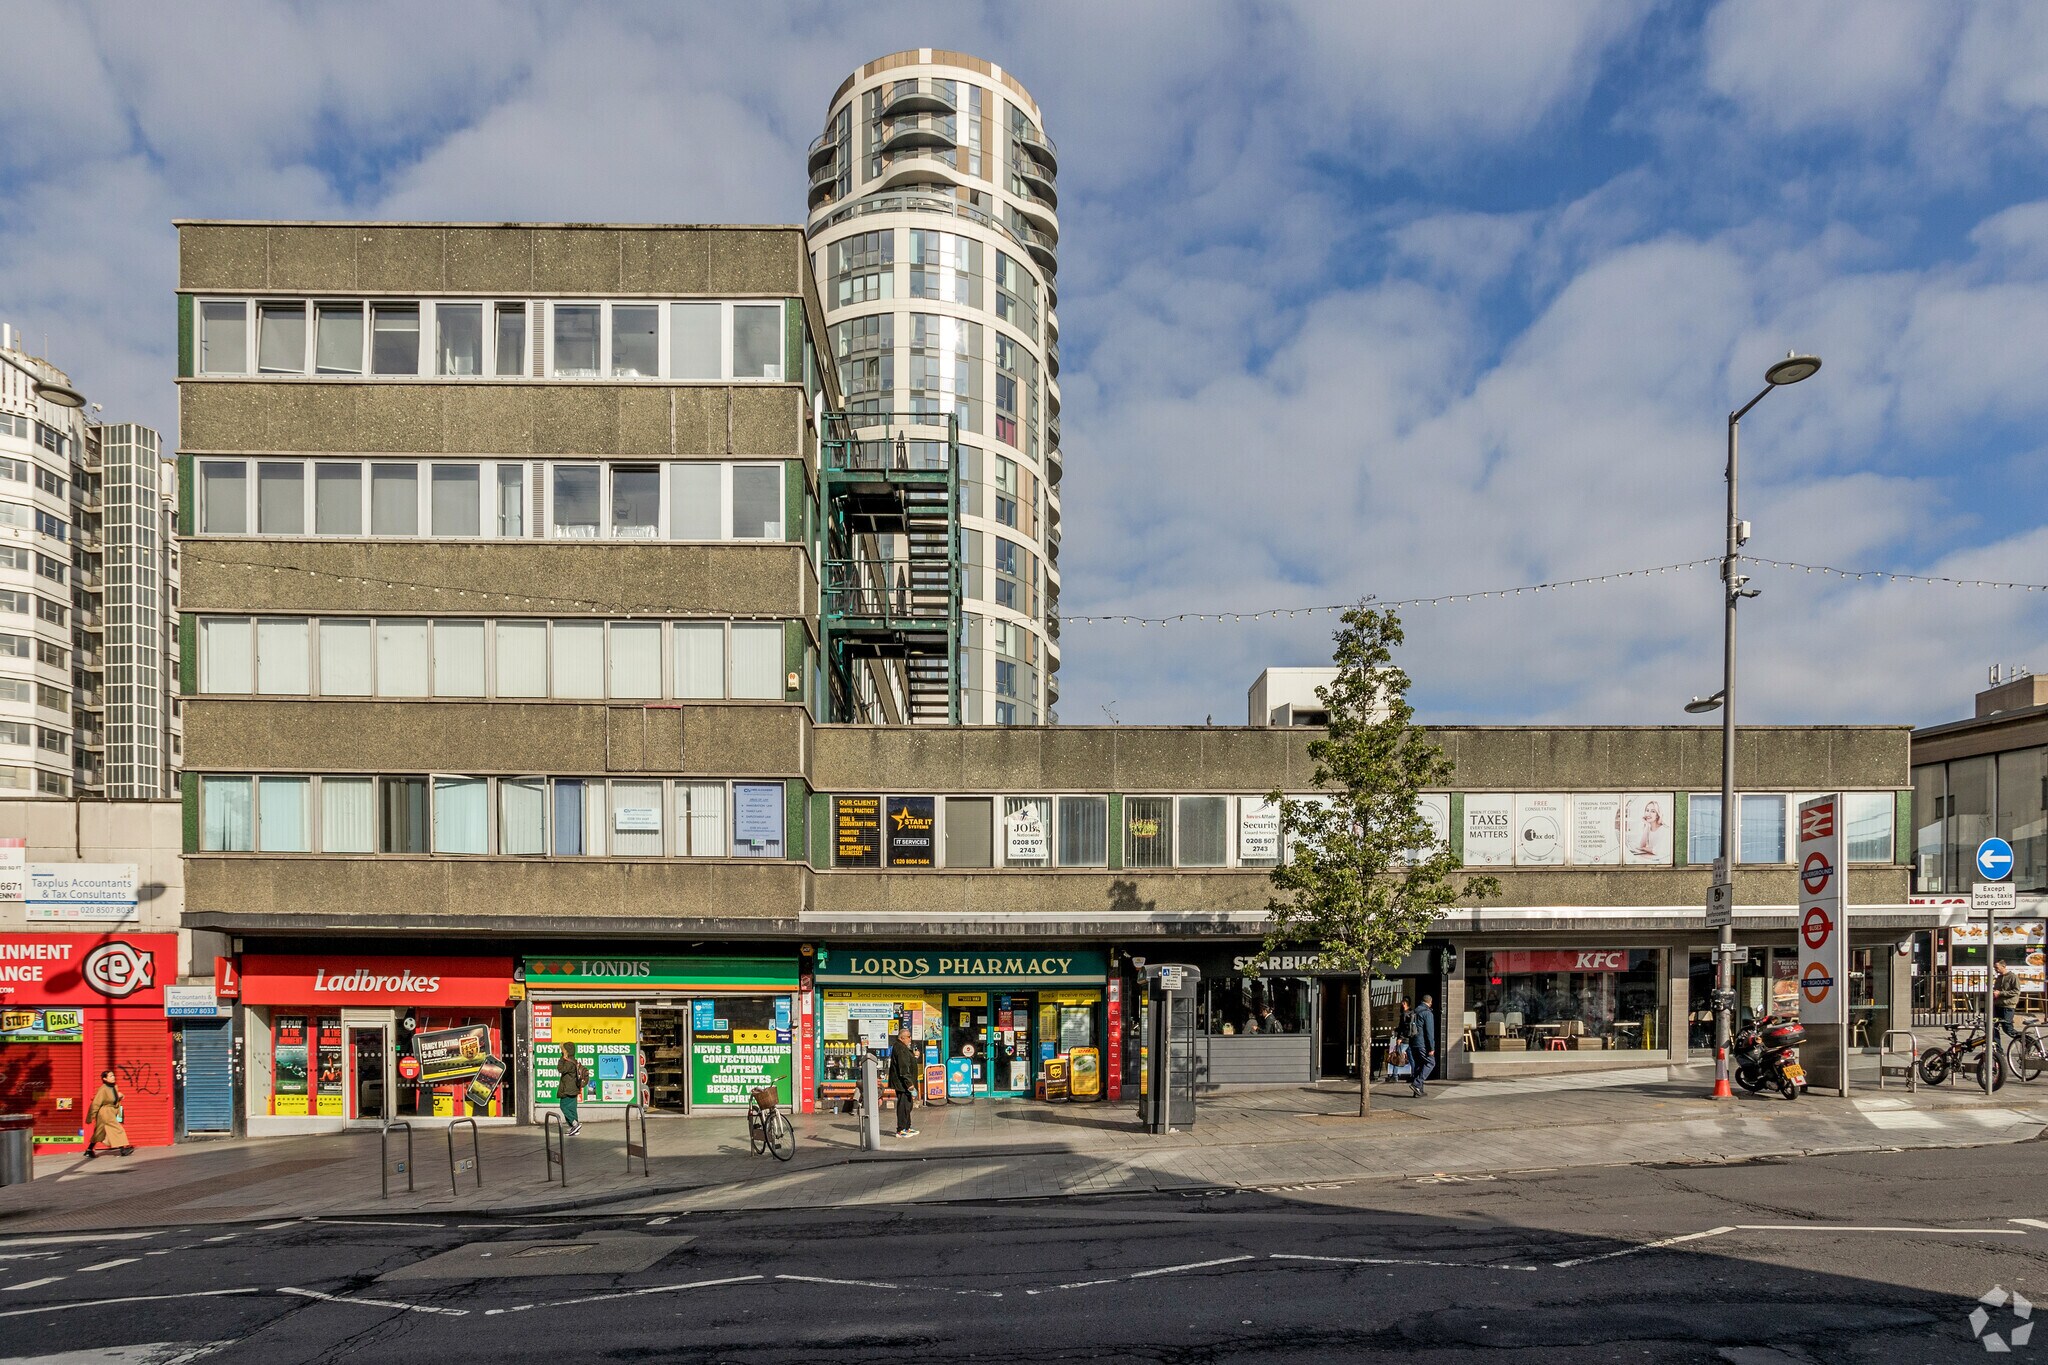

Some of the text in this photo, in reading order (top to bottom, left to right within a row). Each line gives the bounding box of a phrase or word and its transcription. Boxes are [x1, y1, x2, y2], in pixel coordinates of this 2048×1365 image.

[1470, 815, 1508, 825] TAXES
[1243, 822, 1278, 830] Security
[32, 879, 132, 889] Taxplus Accountants
[42, 890, 126, 899] & Tax Consultants
[1575, 953, 1622, 968] KFC
[224, 961, 234, 986] L
[581, 961, 650, 977] LONDIS
[851, 958, 1072, 980] LORDS PHARMACY
[314, 968, 440, 992] Ladbrokes
[5, 1015, 30, 1027] STUFF
[50, 1014, 75, 1026] CASH
[422, 1042, 437, 1051] FANCY
[438, 1039, 459, 1047] PLAYING
[578, 1045, 594, 1053] BUS
[597, 1045, 630, 1053] PASSES
[703, 1055, 780, 1063] CONFECTIONARY
[720, 1065, 763, 1073] LOTTERY
[712, 1075, 771, 1083] CIGARETTES
[707, 1085, 742, 1093] BEERS/
[930, 1086, 942, 1095] Ria
